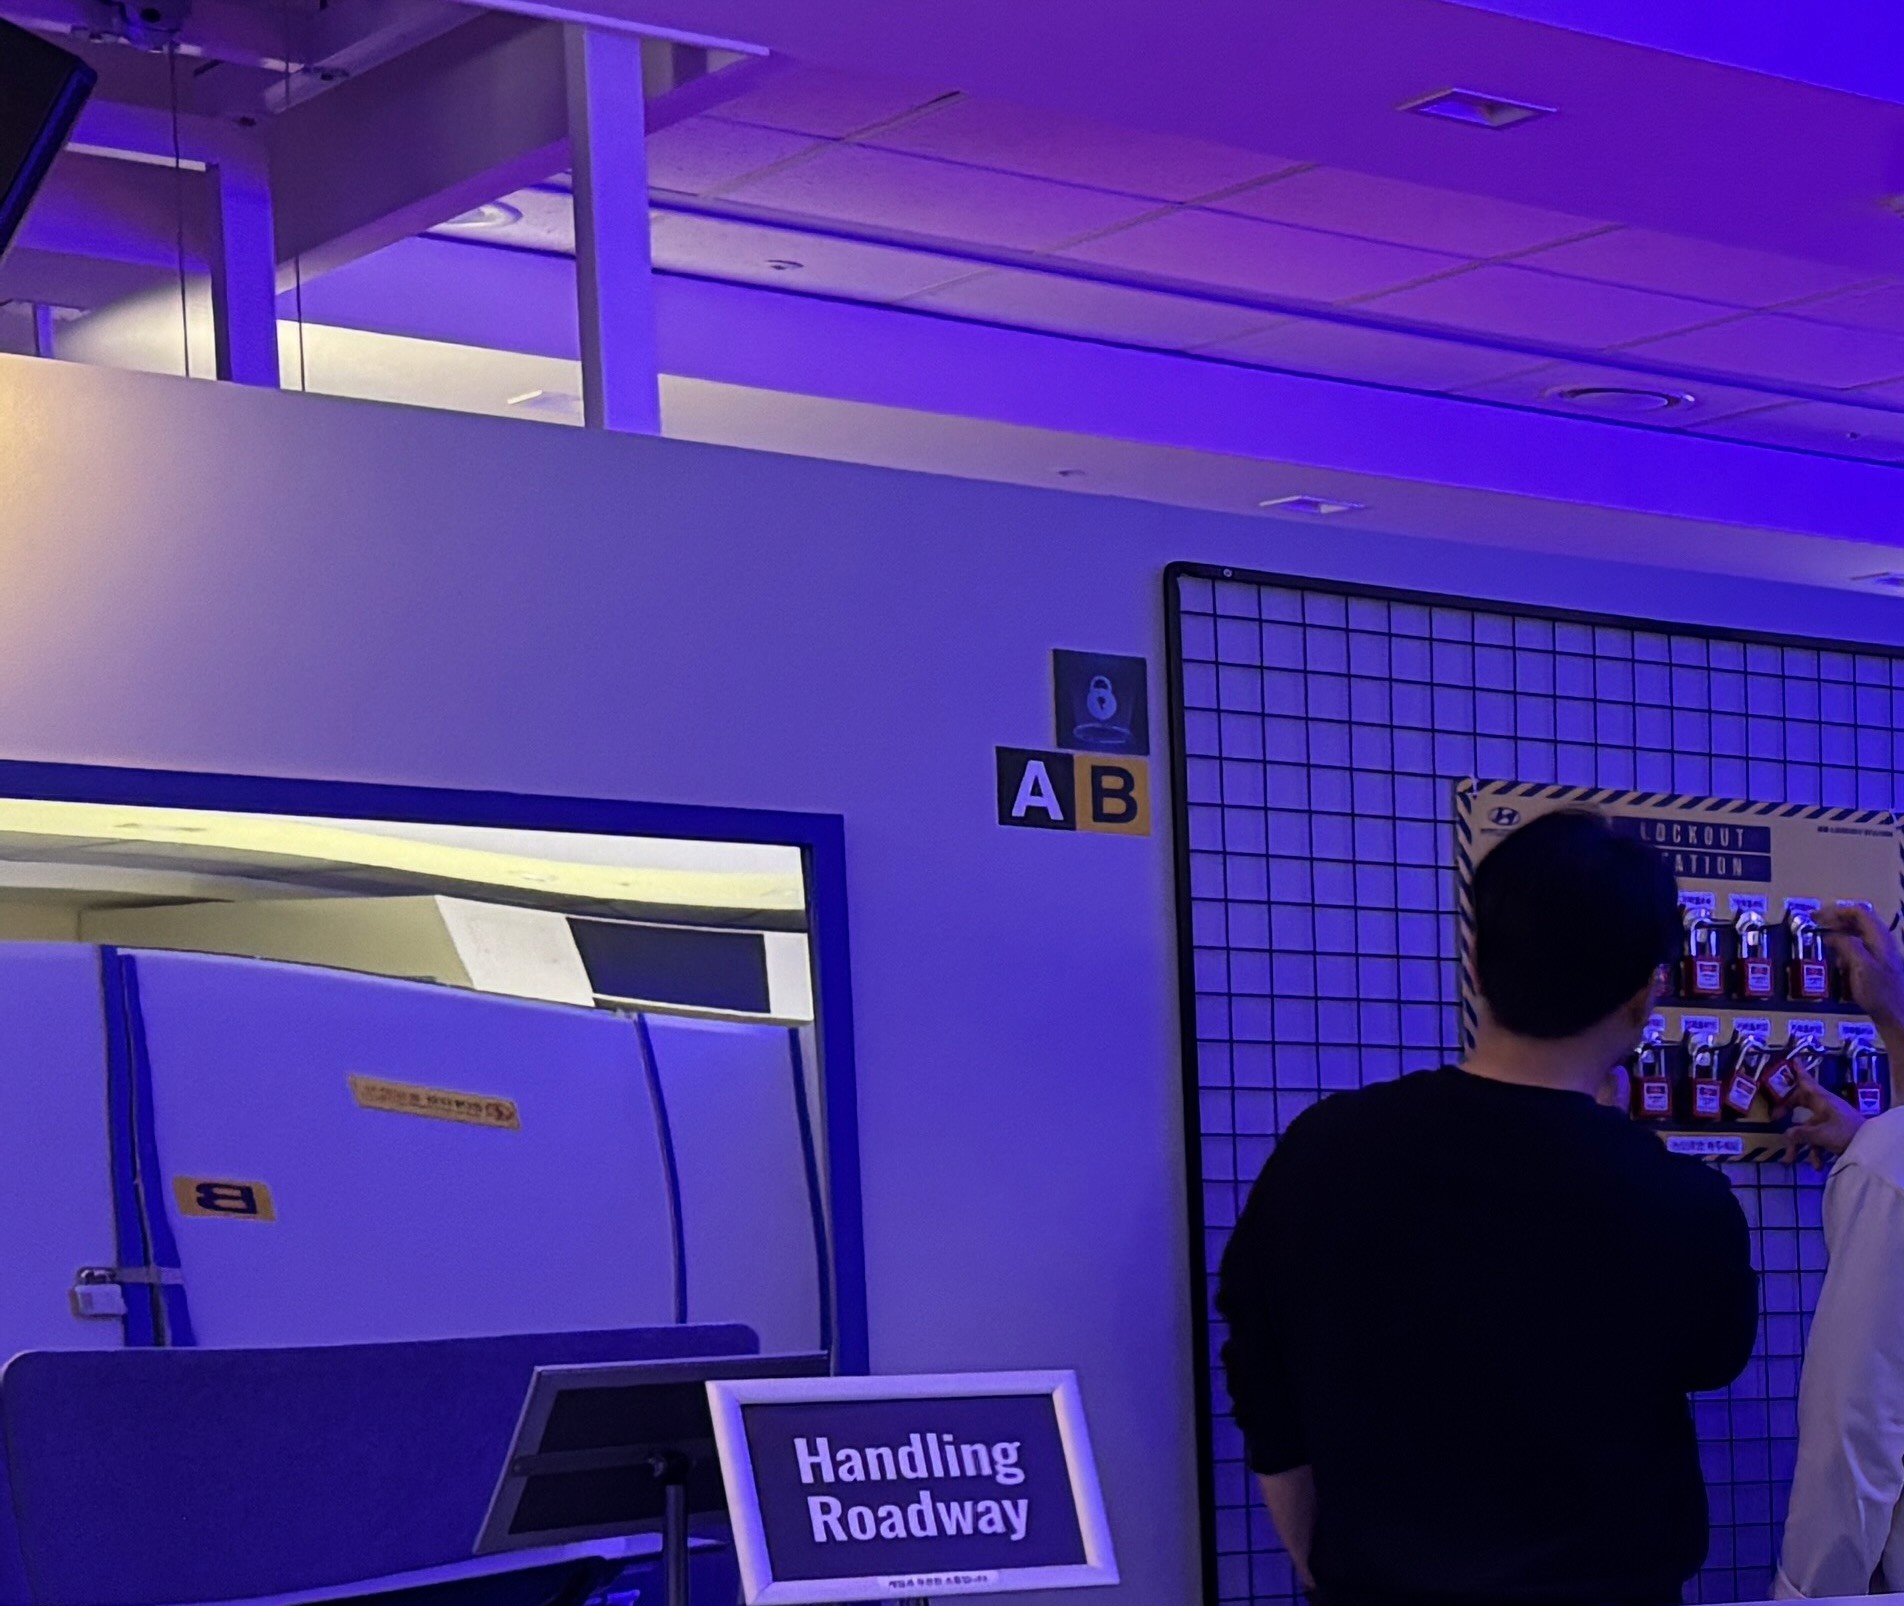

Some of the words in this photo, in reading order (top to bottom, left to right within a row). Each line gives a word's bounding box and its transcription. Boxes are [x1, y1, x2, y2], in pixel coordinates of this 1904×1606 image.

[1010, 758, 1065, 824] A
[1090, 763, 1139, 824] B
[794, 1432, 1025, 1485] Handling
[807, 1490, 1029, 1543] Roadway
